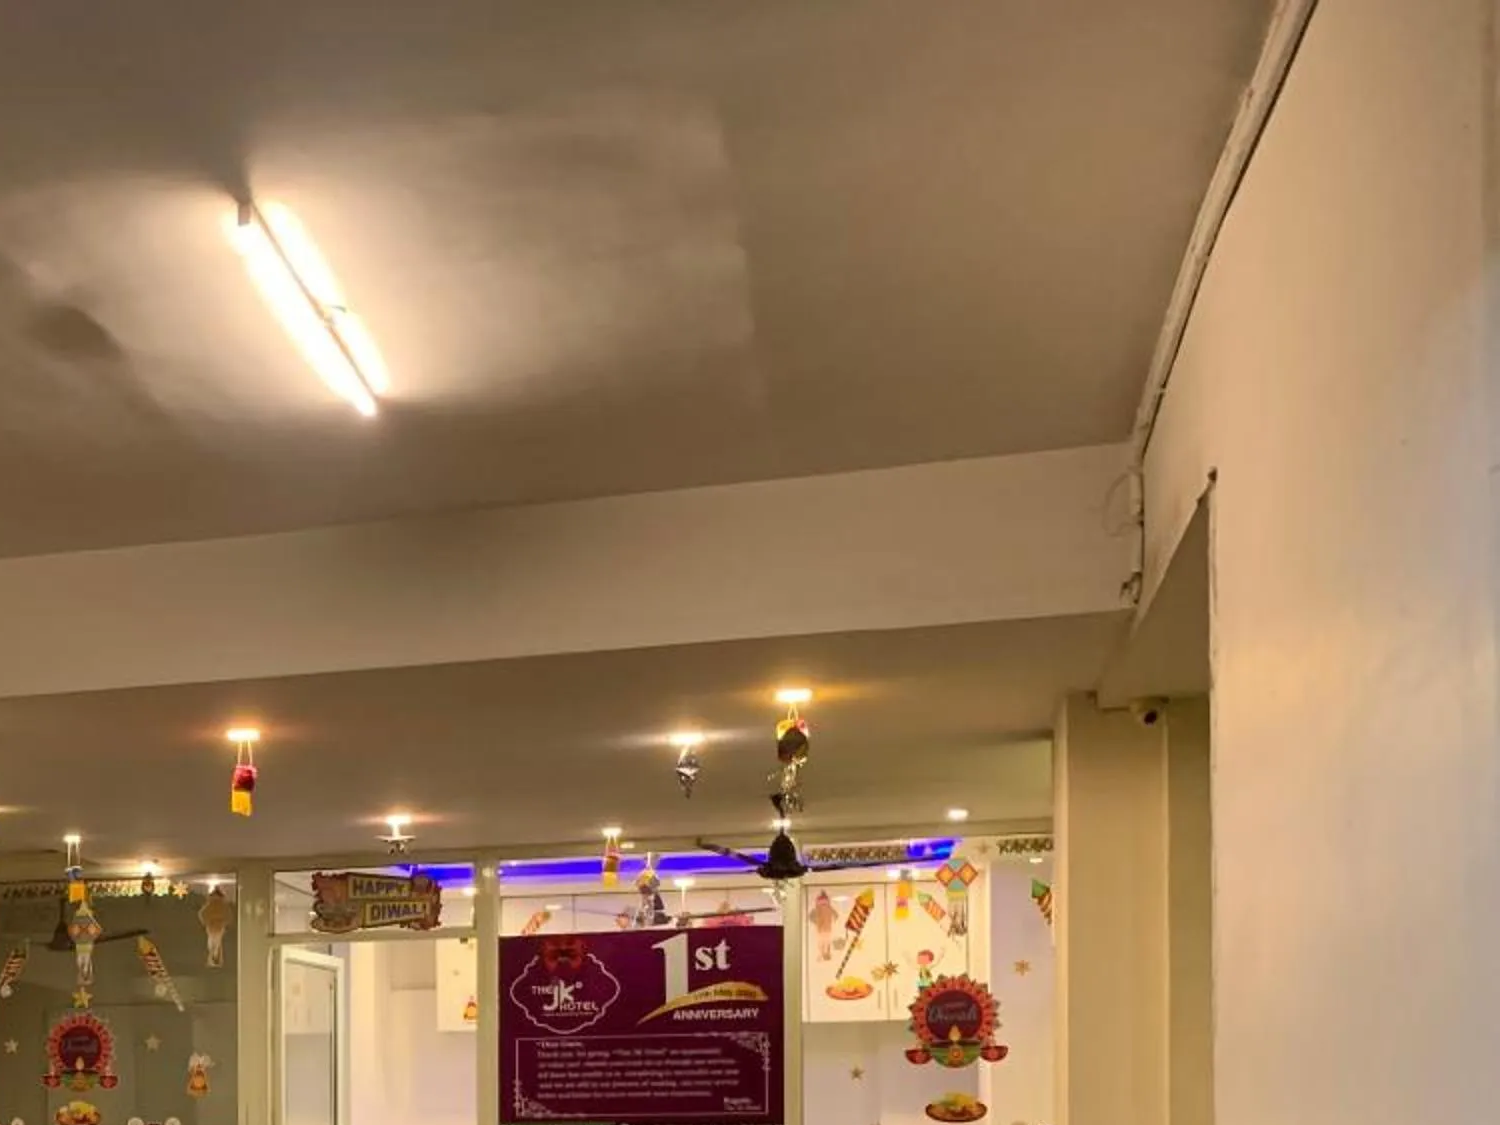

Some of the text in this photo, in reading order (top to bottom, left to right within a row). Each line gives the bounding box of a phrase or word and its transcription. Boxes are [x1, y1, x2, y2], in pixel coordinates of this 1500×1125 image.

[370, 901, 427, 921] DIWALI
[651, 932, 731, 1005] 1st
[560, 1001, 599, 1012] HOTEL
[673, 1008, 759, 1020] ANNIVERSARY
